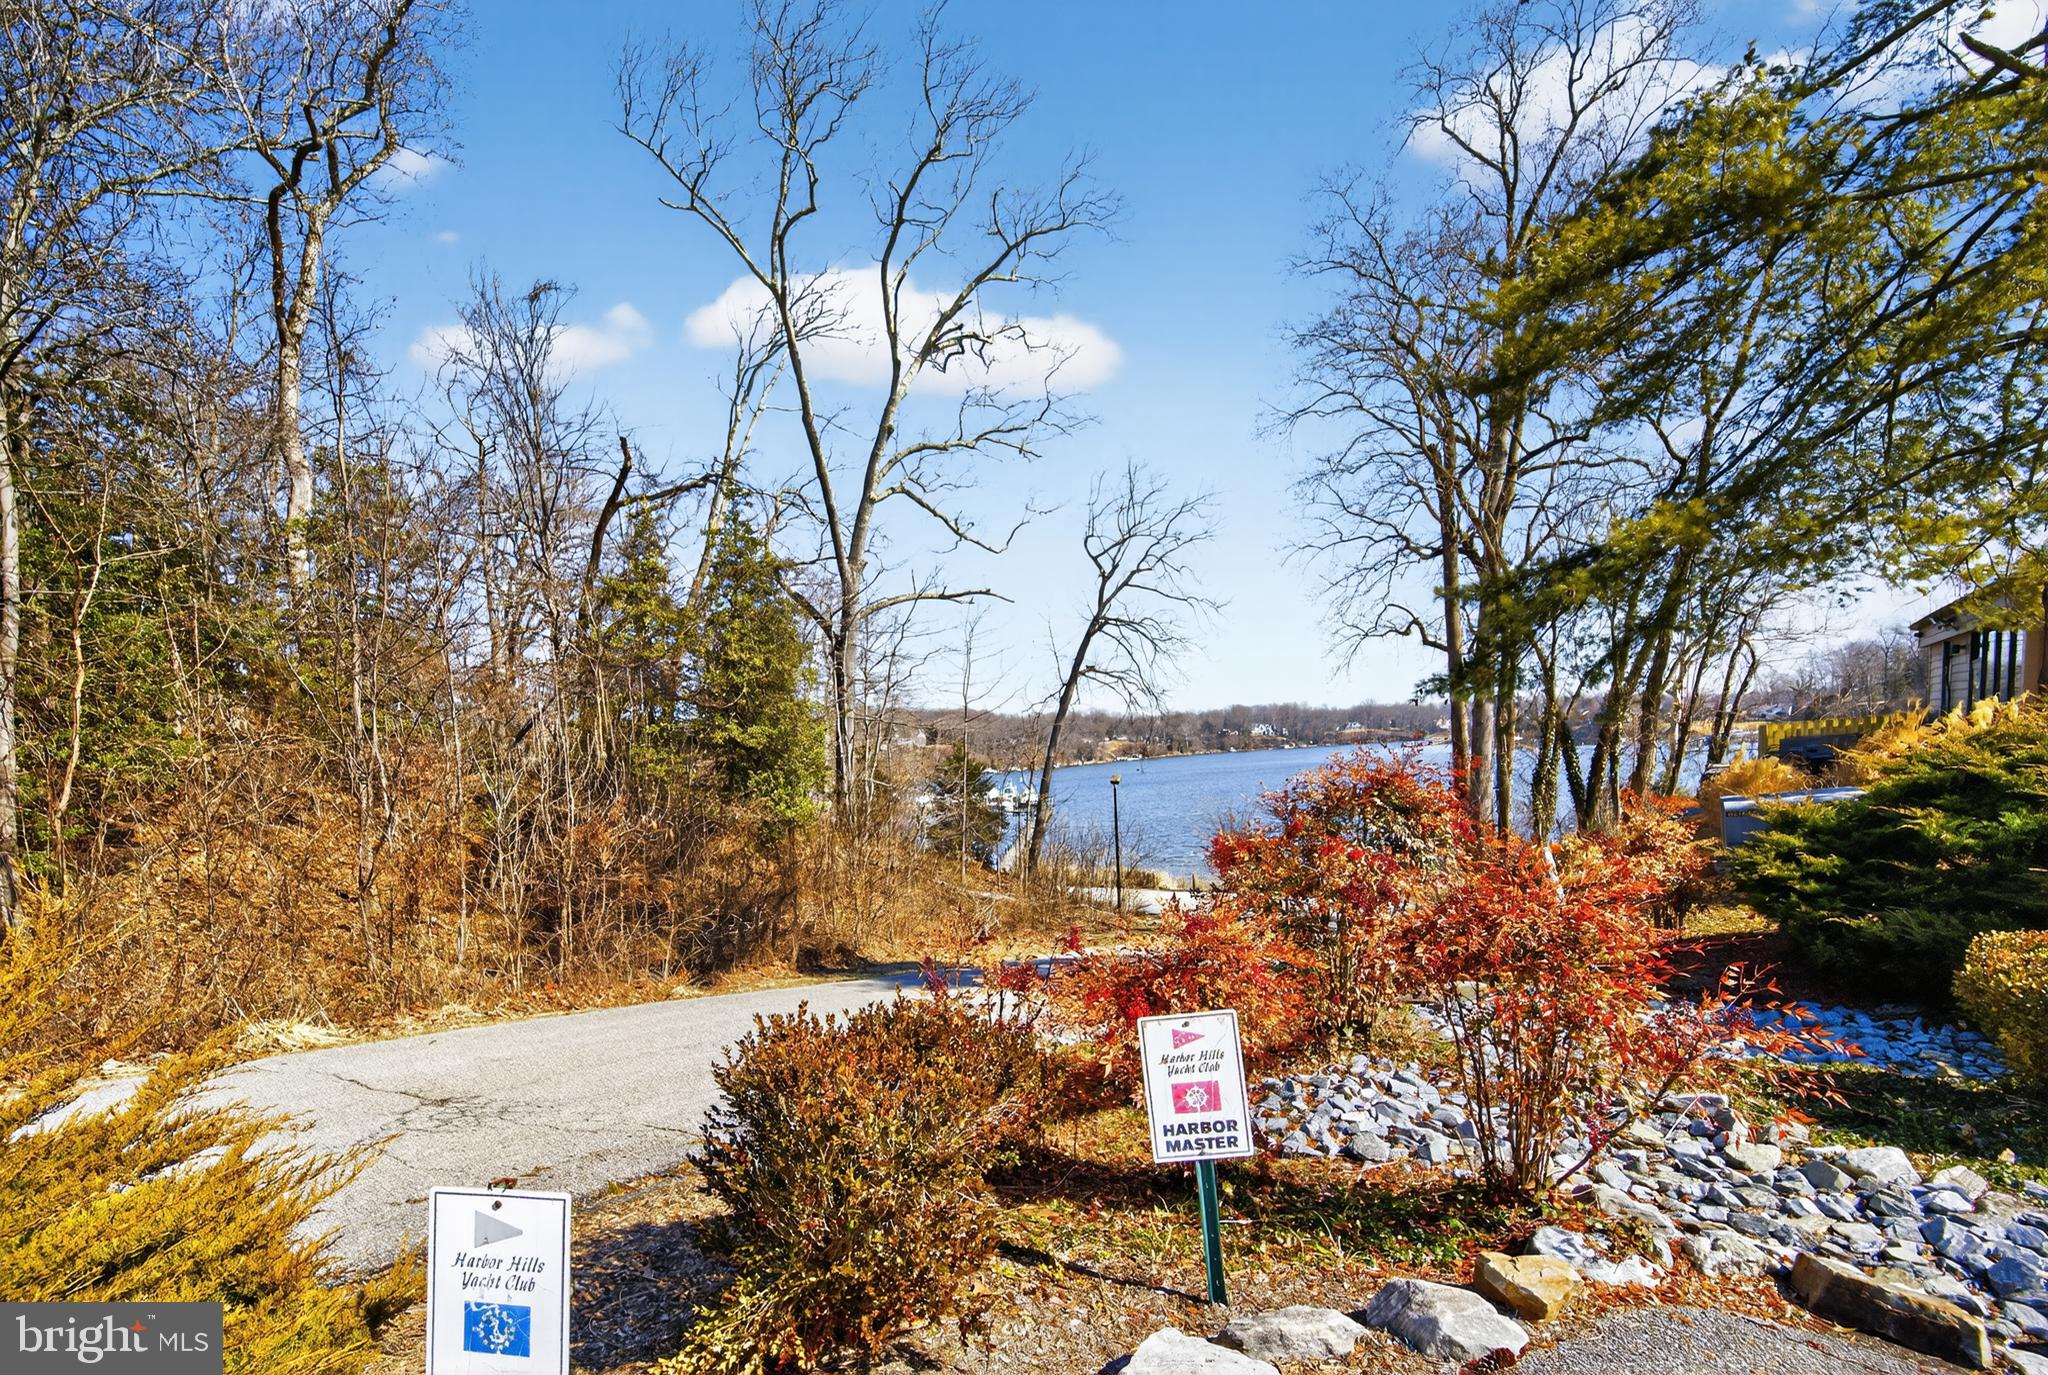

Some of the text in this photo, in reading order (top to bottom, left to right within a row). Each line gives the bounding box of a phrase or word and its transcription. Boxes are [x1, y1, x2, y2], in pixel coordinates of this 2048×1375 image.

[1160, 1049, 1225, 1065] Harbor Hills
[1168, 1061, 1220, 1077] Yacht Club
[1163, 1119, 1239, 1137] HARBOR
[1166, 1136, 1239, 1152] MASTER
[451, 1252, 545, 1273] Harbor Hills
[461, 1271, 536, 1292] Yacht Club
